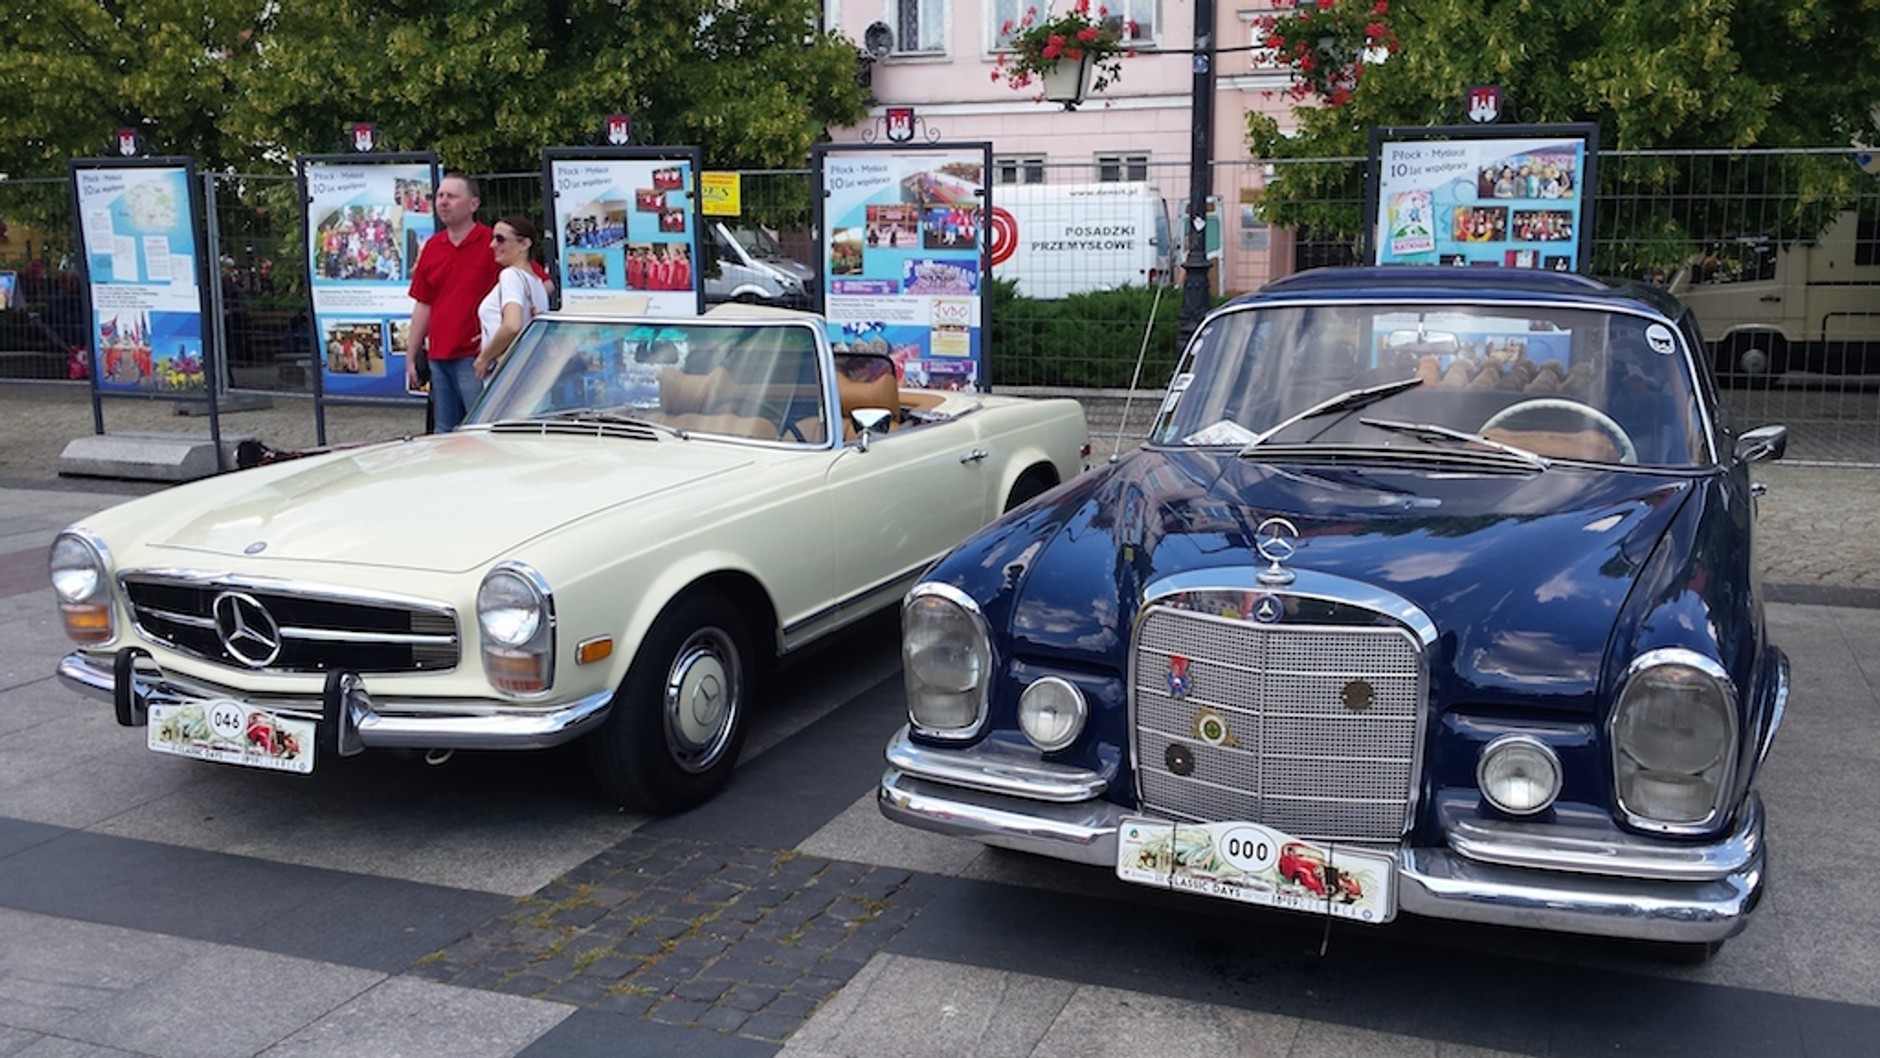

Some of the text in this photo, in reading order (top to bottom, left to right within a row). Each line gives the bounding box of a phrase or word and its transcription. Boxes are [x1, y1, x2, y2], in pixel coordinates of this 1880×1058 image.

[1391, 163, 1408, 178] 10
[313, 182, 326, 194] 10
[558, 178, 570, 190] 10
[830, 176, 844, 190] 10
[1065, 226, 1136, 237] POSADZKI
[1031, 239, 1136, 251] PRZEMYSŁOWE
[215, 712, 240, 730] 046
[1228, 837, 1269, 861] 000
[1166, 873, 1209, 892] CLASSIC
[1211, 884, 1241, 898] DAYS
